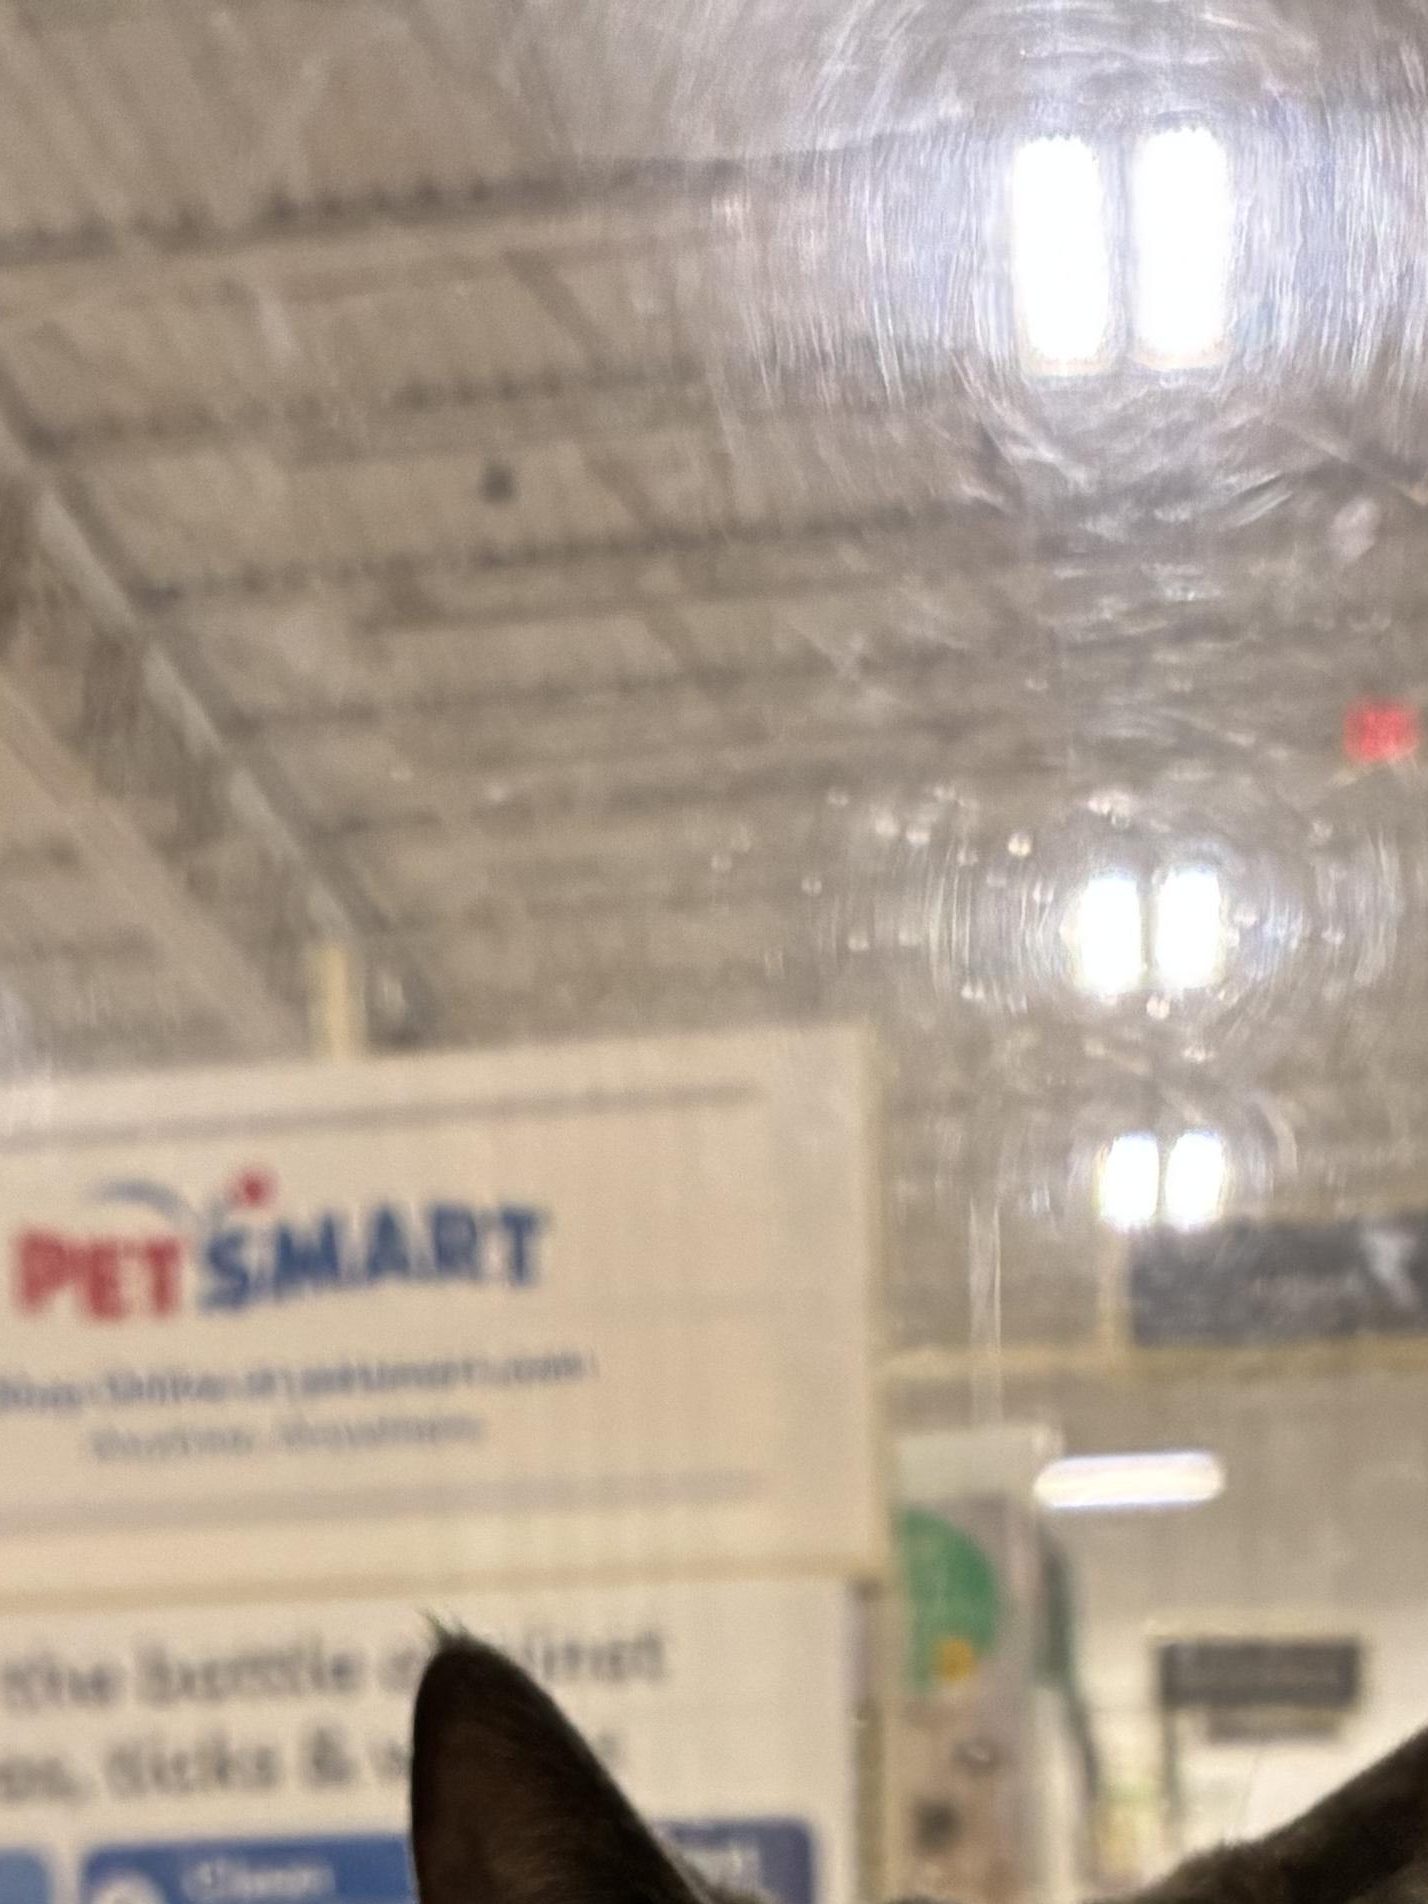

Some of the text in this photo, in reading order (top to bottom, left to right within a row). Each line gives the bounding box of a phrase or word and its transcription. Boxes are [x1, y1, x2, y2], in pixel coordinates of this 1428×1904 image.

[18, 1200, 546, 1322] PETSMART
[0, 1646, 122, 1714] the
[133, 1636, 364, 1706] battle
[105, 1732, 281, 1798] ticks
[298, 1720, 356, 1790] &
